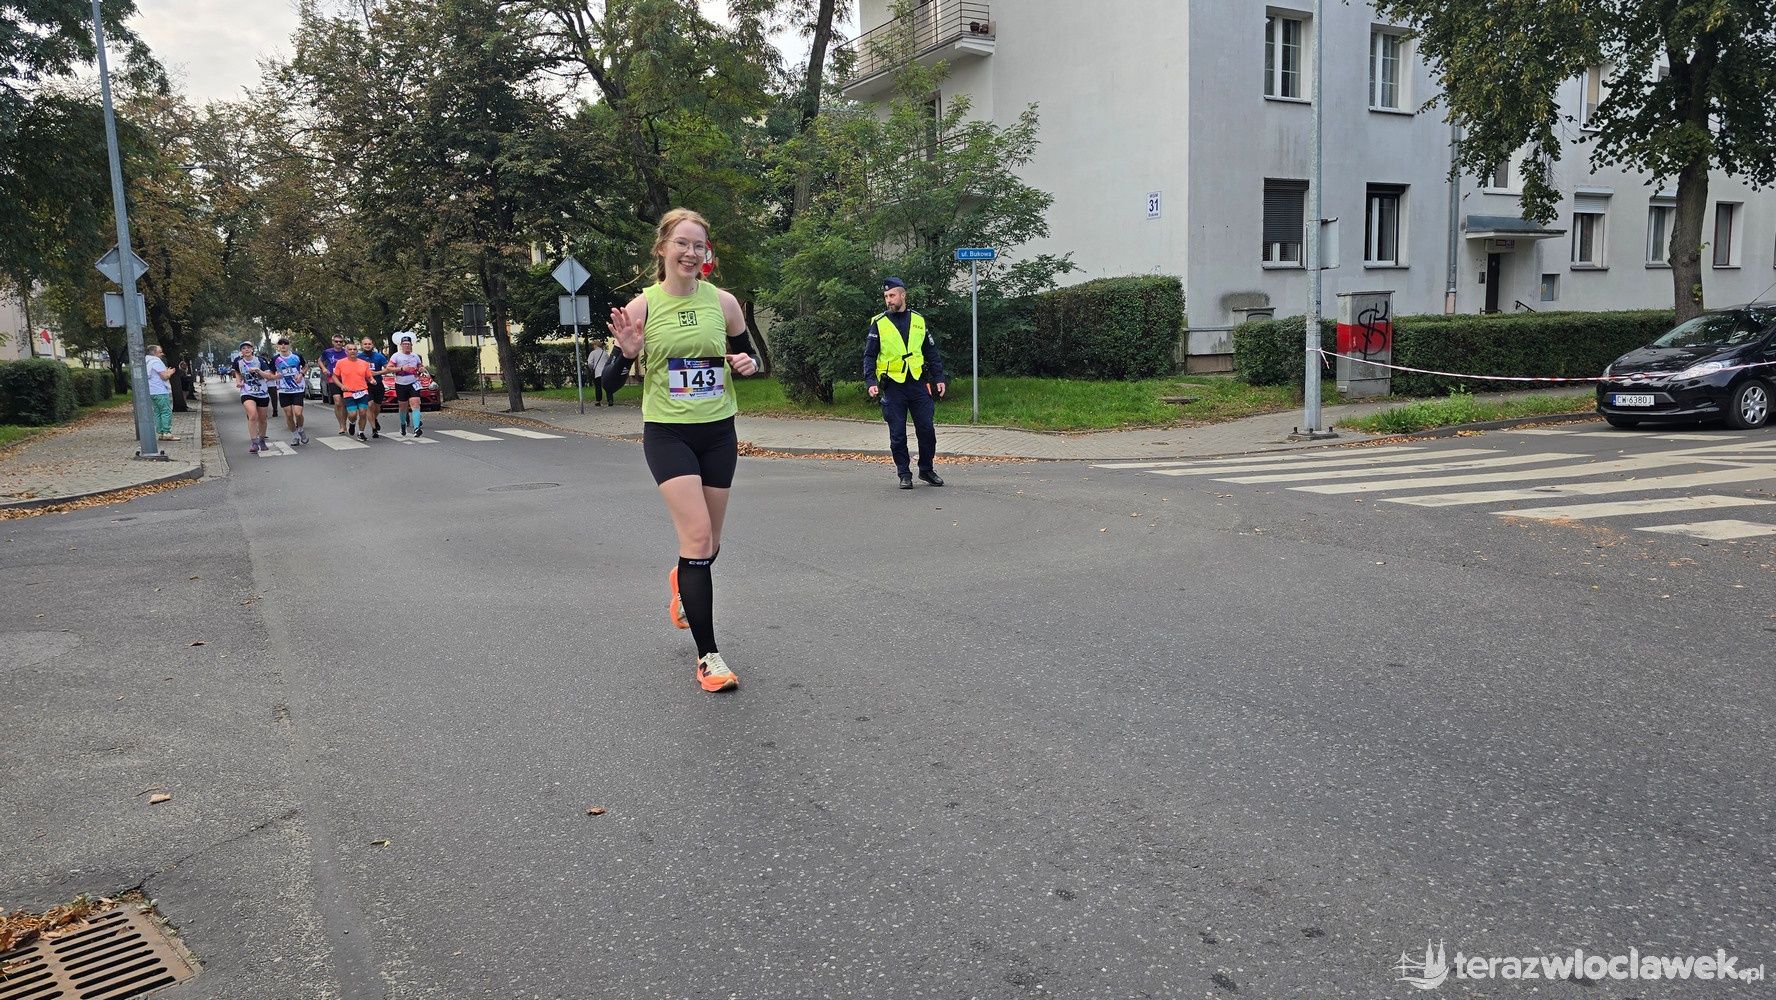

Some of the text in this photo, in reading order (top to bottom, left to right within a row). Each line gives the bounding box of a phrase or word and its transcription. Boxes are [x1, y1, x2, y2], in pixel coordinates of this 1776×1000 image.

[1149, 199, 1159, 212] 31
[680, 369, 716, 388] 143
[1617, 395, 1627, 404] CW
